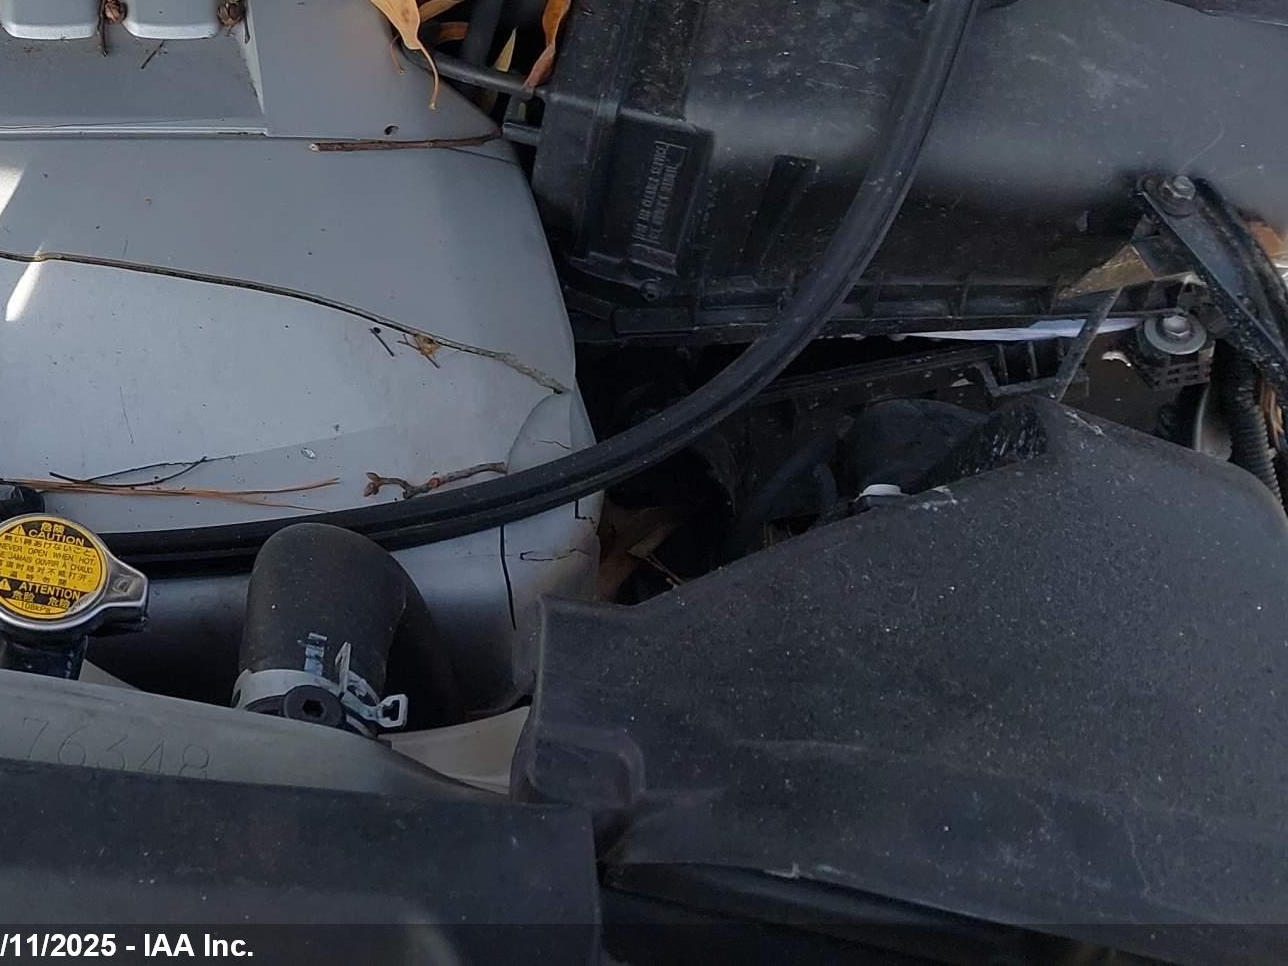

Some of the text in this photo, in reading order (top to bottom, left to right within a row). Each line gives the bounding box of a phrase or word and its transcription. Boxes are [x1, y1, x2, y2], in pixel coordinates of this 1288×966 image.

[28, 529, 85, 547] CAUTION
[0, 542, 23, 553] NEVER
[27, 547, 48, 558] OPEN
[52, 551, 73, 562] WHEN
[7, 553, 33, 564] JAMAIS
[34, 558, 60, 567] OUVRIR
[19, 581, 81, 600] ATTENTION
[20, 601, 51, 613] 108kPa
